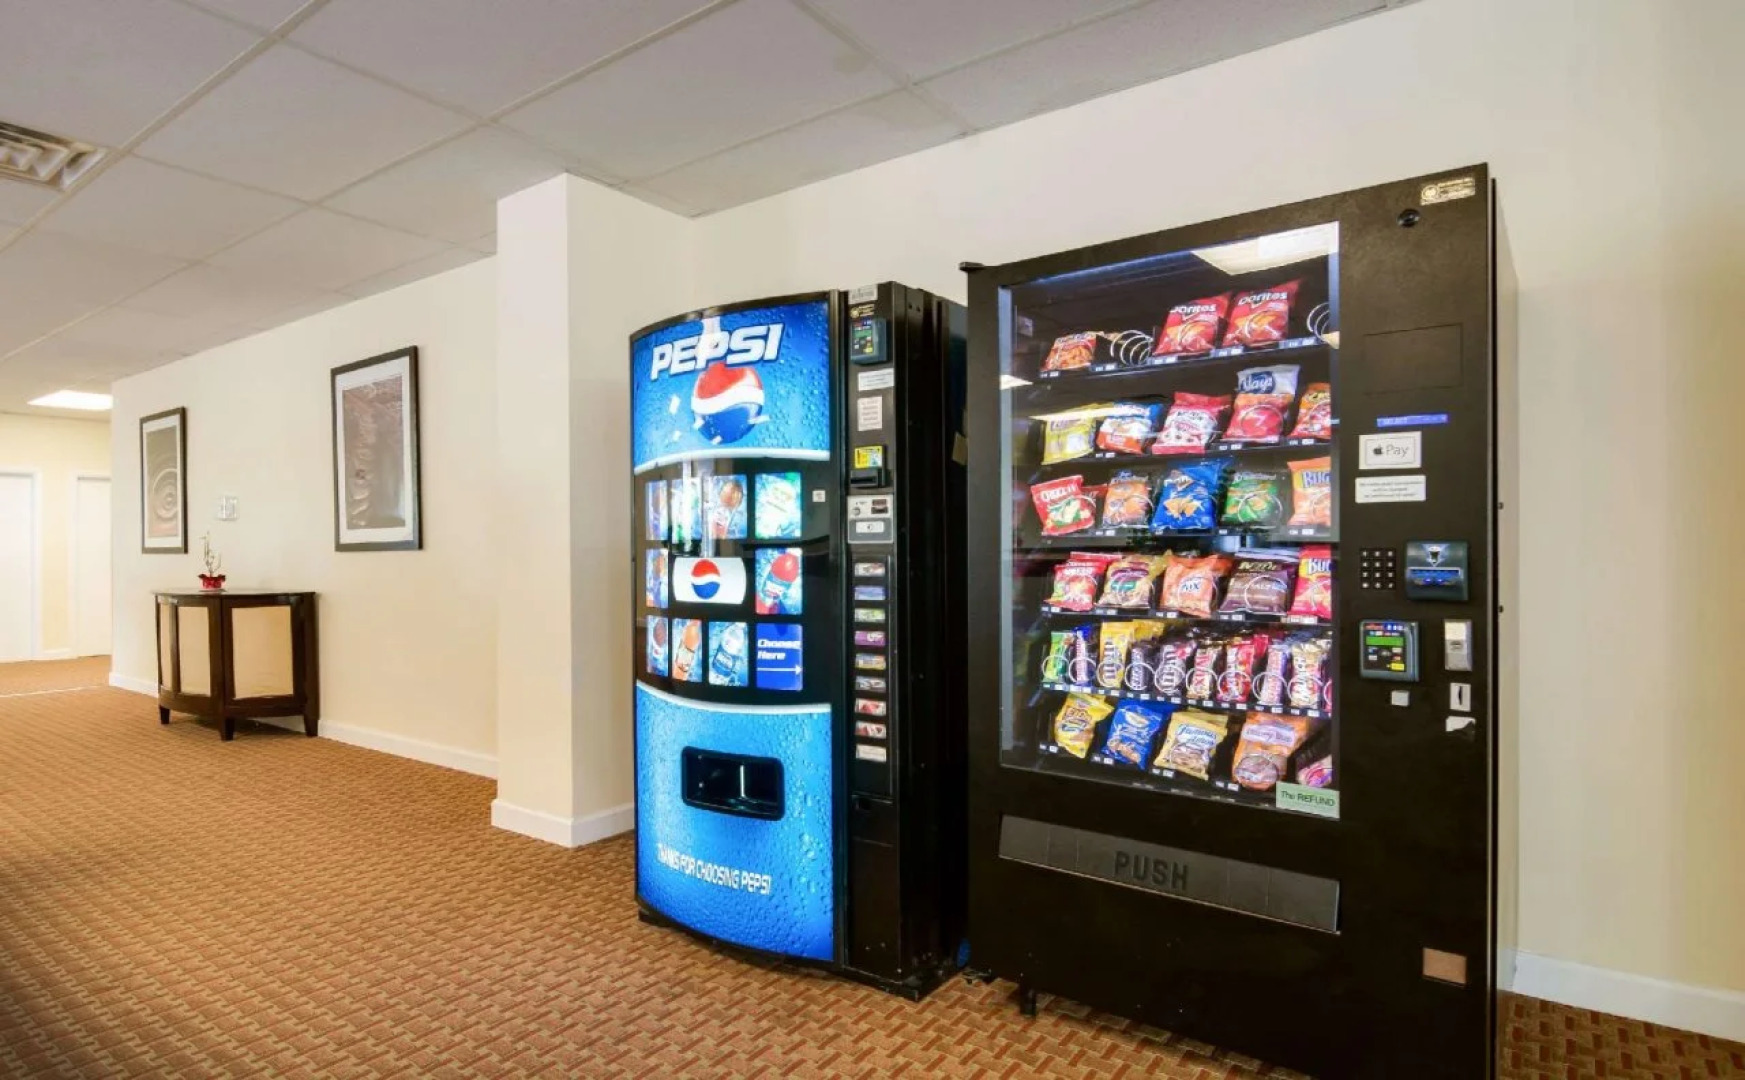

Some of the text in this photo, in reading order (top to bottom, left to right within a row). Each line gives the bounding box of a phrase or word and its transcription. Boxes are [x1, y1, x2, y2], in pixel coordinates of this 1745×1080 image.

[650, 323, 784, 380] PEPSI
[1386, 444, 1410, 458] Pay
[1297, 793, 1336, 807] REFUND
[696, 859, 740, 890] CHOOSING
[740, 870, 772, 896] PEPSI
[1113, 850, 1189, 891] PUSH
